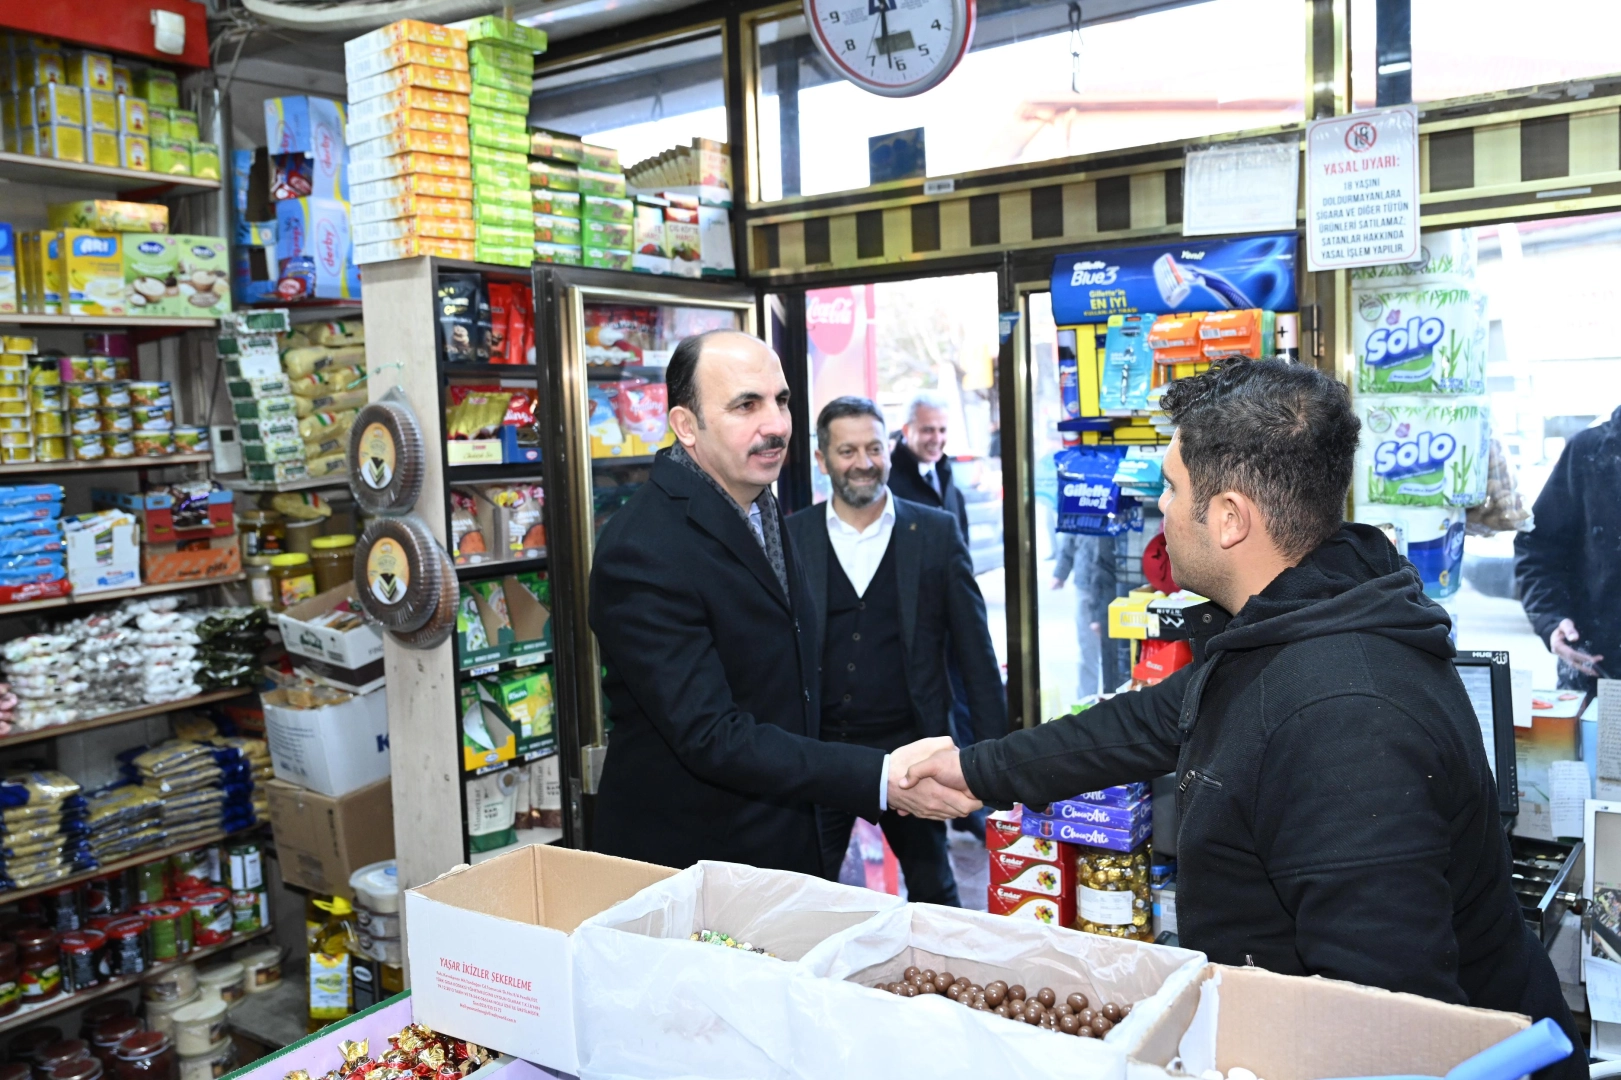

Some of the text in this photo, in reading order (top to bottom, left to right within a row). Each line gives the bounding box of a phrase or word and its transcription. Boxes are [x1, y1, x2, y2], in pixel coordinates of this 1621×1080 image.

[829, 11, 841, 24] 9
[930, 19, 942, 31] 4
[844, 39, 856, 51] 8
[918, 44, 930, 57] 5
[866, 55, 876, 67] 7
[895, 59, 907, 71] 6
[1323, 160, 1359, 176] YASAL
[1343, 181, 1353, 191] 18
[1322, 189, 1402, 207] DOLDURMAYANLARA
[1316, 201, 1409, 221] SİGARA VE DİĞER TÜTÜN
[1318, 220, 1357, 234] ÜRÜNLERİ
[1321, 229, 1404, 247] SATANLAR HAKKINDA
[322, 230, 335, 268] derby
[1321, 249, 1345, 260] YASAL
[1347, 246, 1371, 259] İŞLEM
[1073, 260, 1106, 271] Gillette
[1070, 265, 1120, 287] Blue3
[1090, 296, 1128, 310] EN İYİ
[1063, 483, 1112, 498] Gillette
[439, 957, 461, 971] YAŞAR
[462, 961, 490, 980] İKİZLER
[490, 971, 532, 992] ŞEKERLEME
